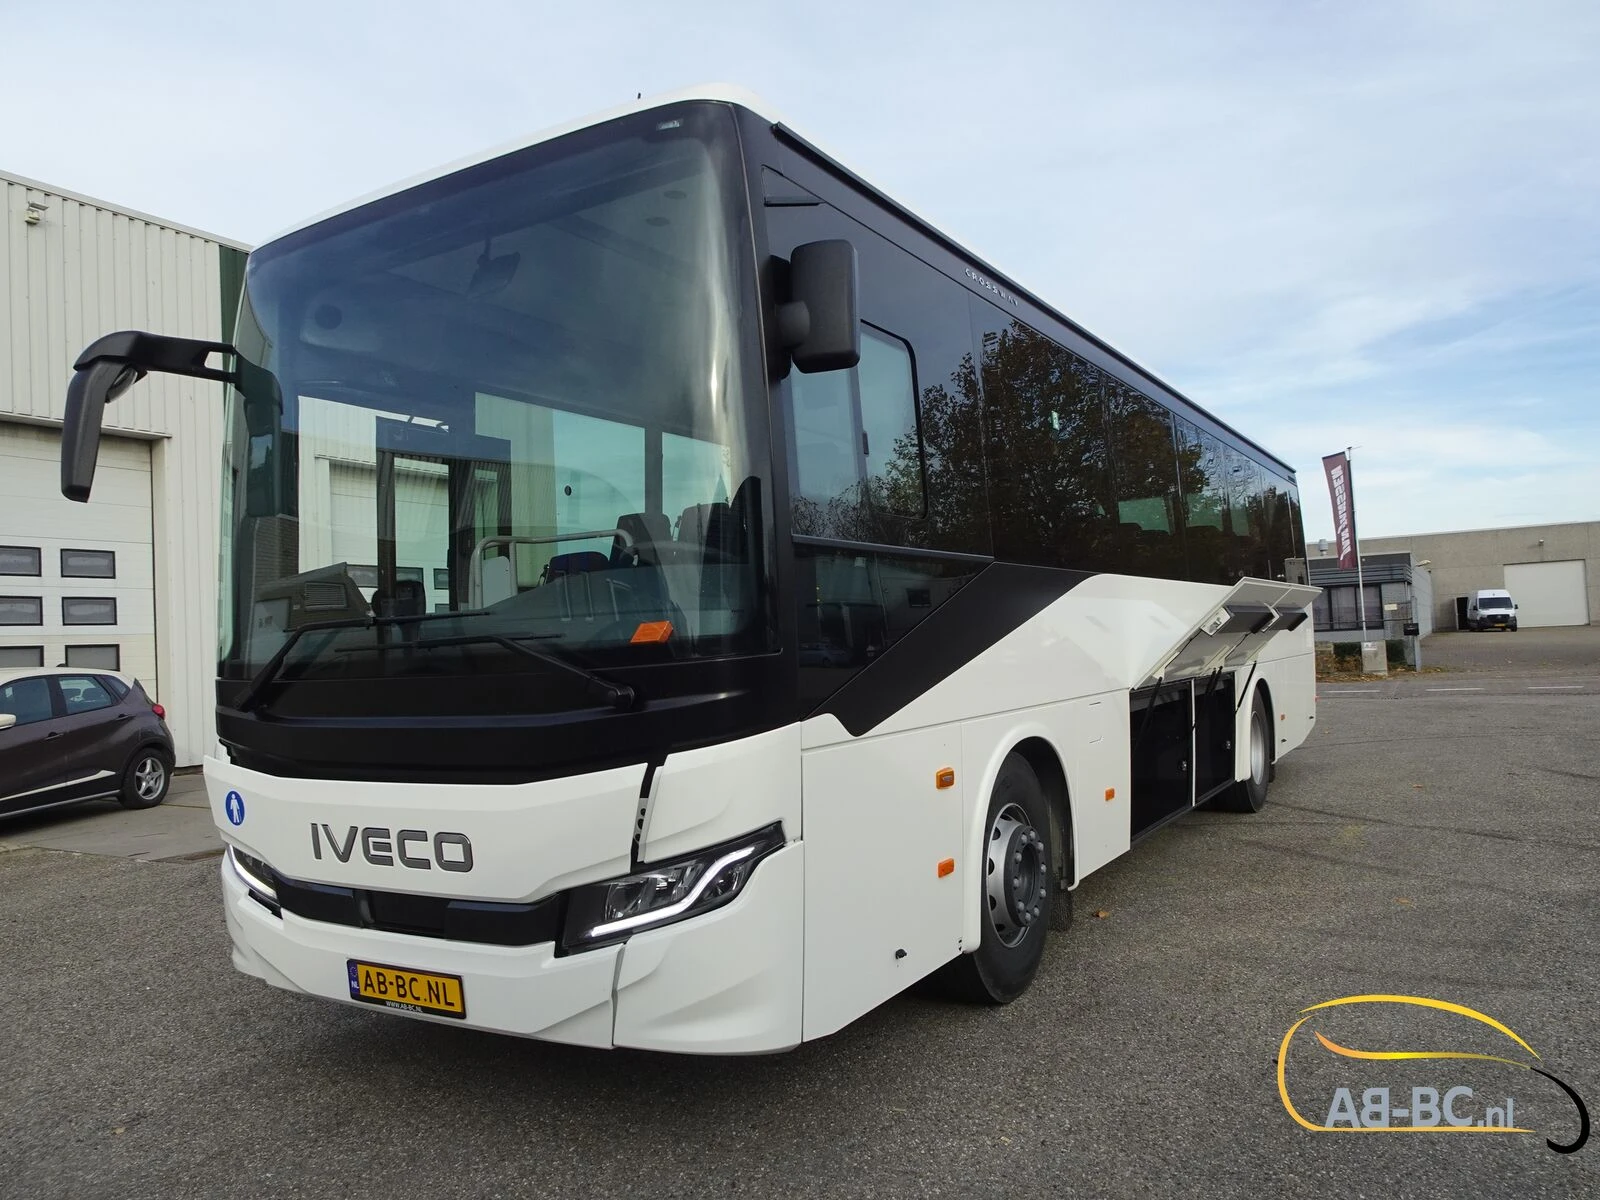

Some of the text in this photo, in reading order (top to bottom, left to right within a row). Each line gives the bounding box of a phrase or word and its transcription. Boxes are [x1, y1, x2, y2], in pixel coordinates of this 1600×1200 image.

[310, 822, 474, 873] IVECO
[351, 980, 360, 989] NL
[364, 970, 455, 1007] AB-BC.NL
